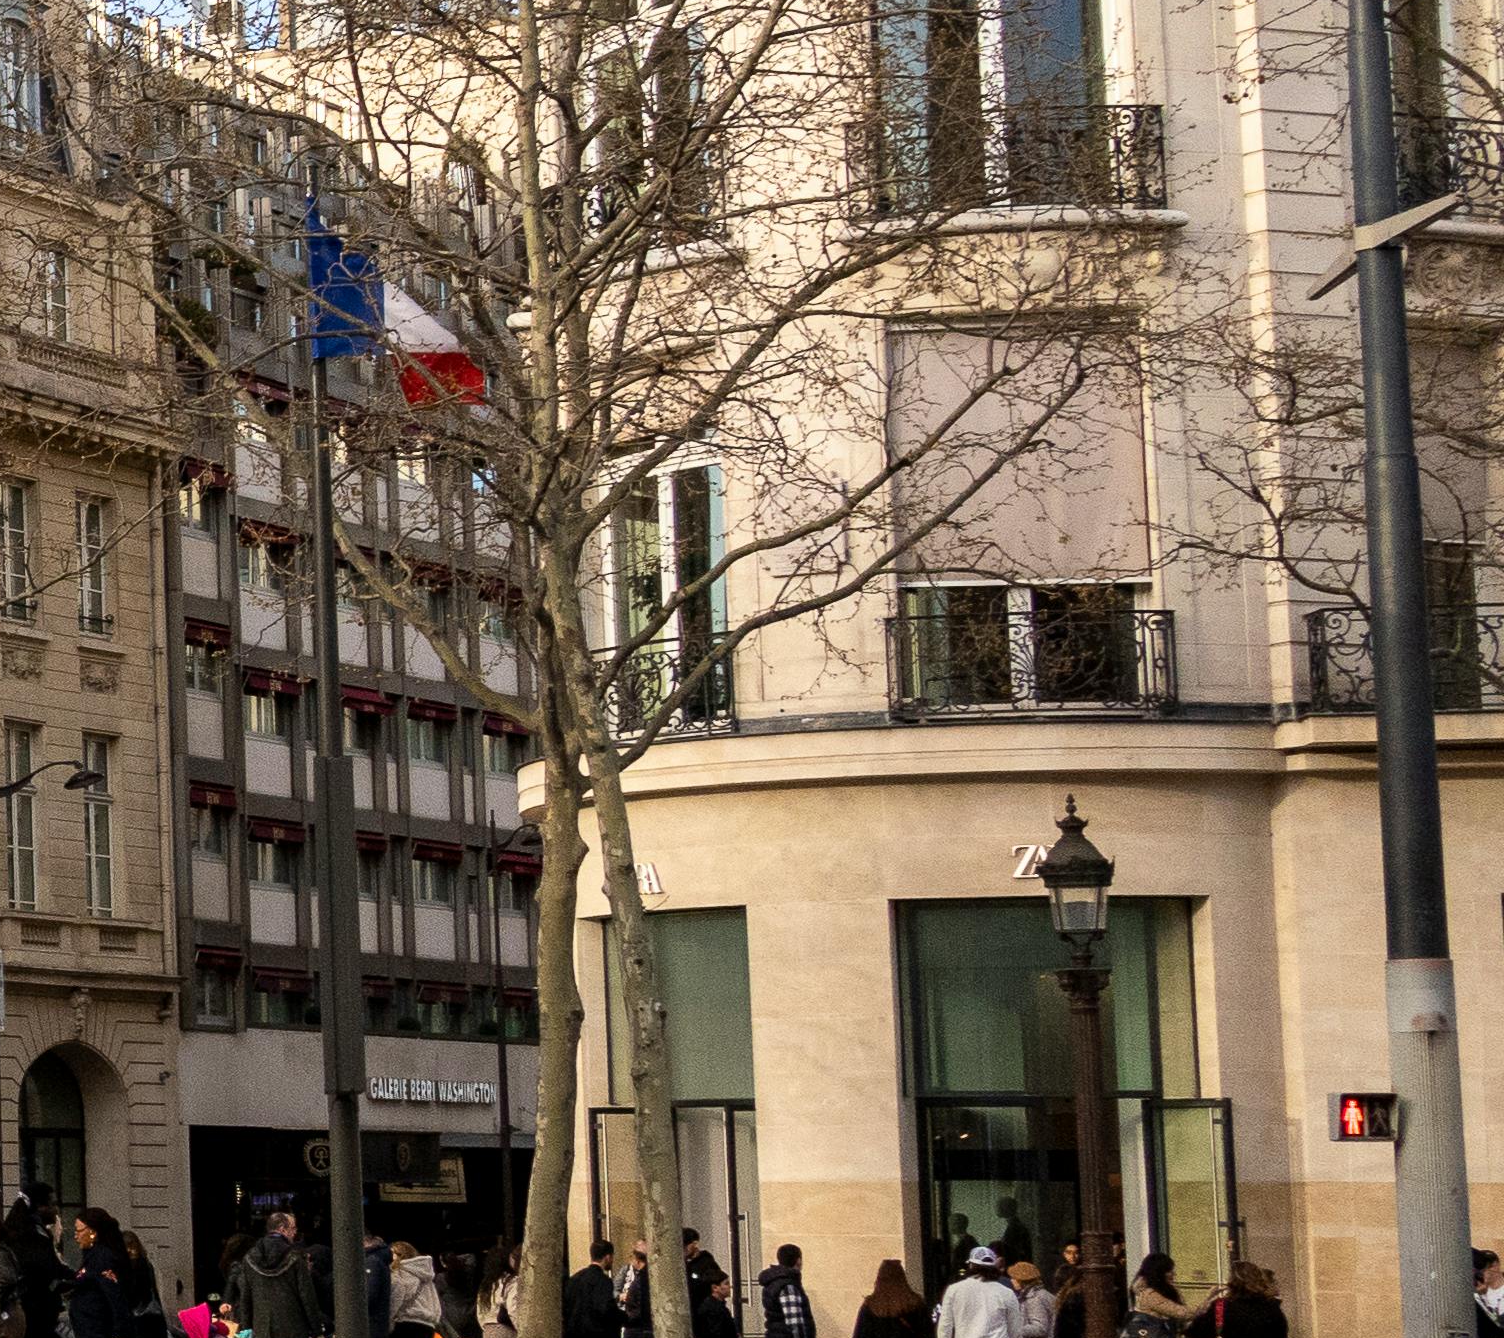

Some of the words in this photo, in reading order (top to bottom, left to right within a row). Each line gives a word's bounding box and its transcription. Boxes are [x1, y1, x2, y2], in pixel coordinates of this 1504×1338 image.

[370, 1077, 408, 1100] GALERIE
[410, 1079, 436, 1101] BERRI
[437, 1080, 498, 1103] WASHINGTON
